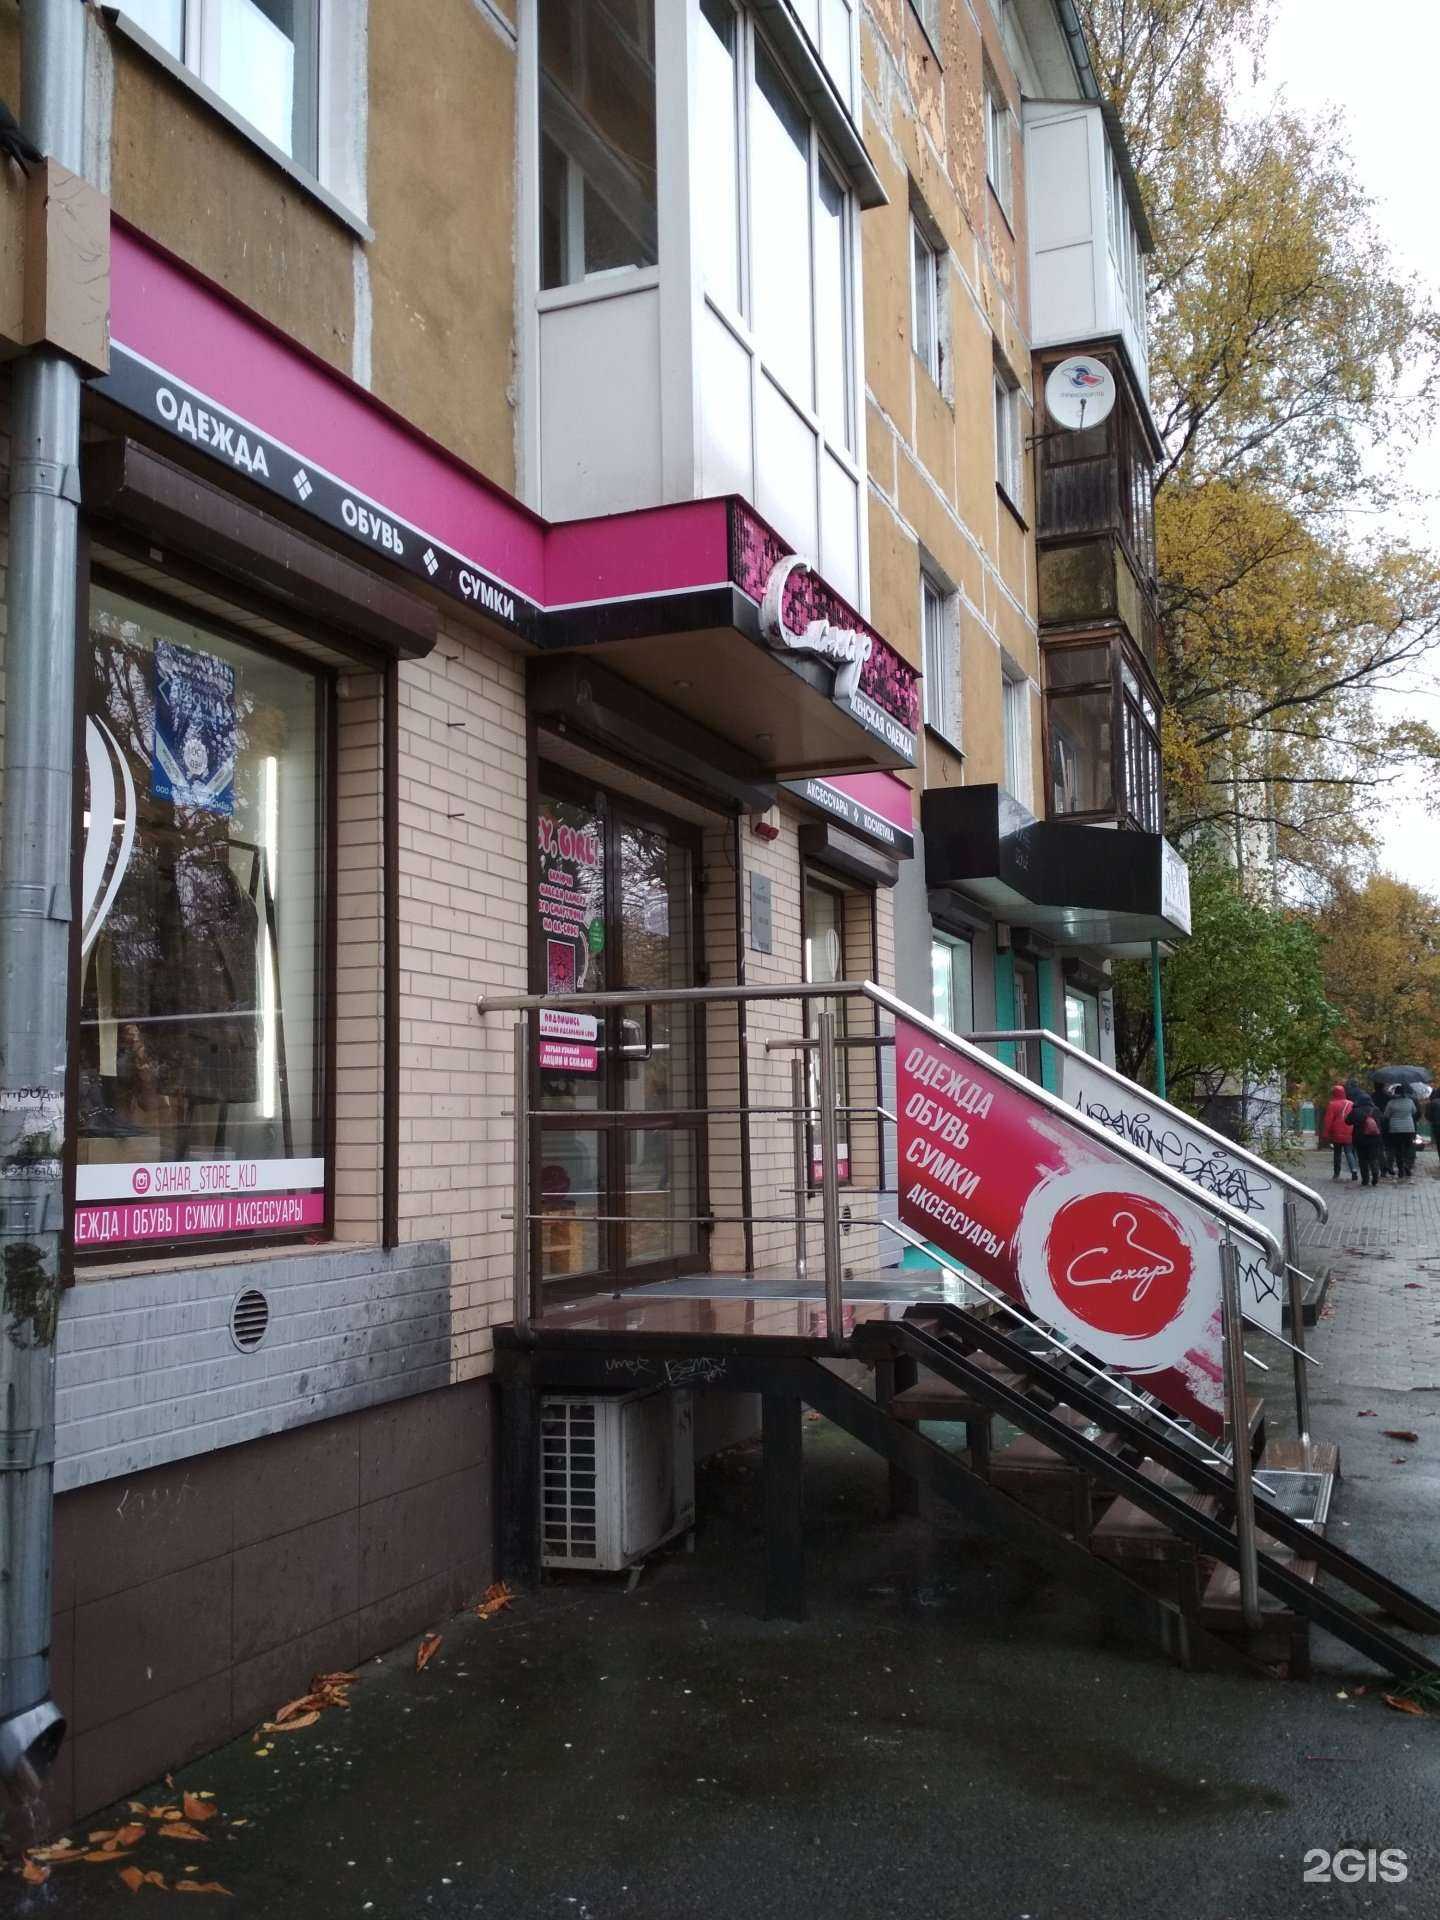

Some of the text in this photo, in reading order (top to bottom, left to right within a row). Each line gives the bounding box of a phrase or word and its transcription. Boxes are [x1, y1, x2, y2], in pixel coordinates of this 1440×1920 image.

[156, 387, 515, 622] ОДЕЖДА ОБУВЬ СУМКИ
[886, 721, 913, 757] ОДЕЖДА
[806, 781, 895, 844] АКСЕССУАРЫ КОСМЕТИКА
[904, 1047, 994, 1120] ОДЕЖДА
[905, 1092, 970, 1150] ОБУВЬ
[155, 1164, 257, 1193] SAHAR_STORE_KLD
[905, 1137, 982, 1200] СУМКИ
[133, 1208, 172, 1235] ОБУВЬ
[185, 1203, 224, 1230] СУМКИ
[236, 1198, 303, 1225] АКСЕССУАРЫ
[906, 1183, 1005, 1258] АКСЕССУАРЫ
[1067, 1247, 1175, 1302] Сахар
